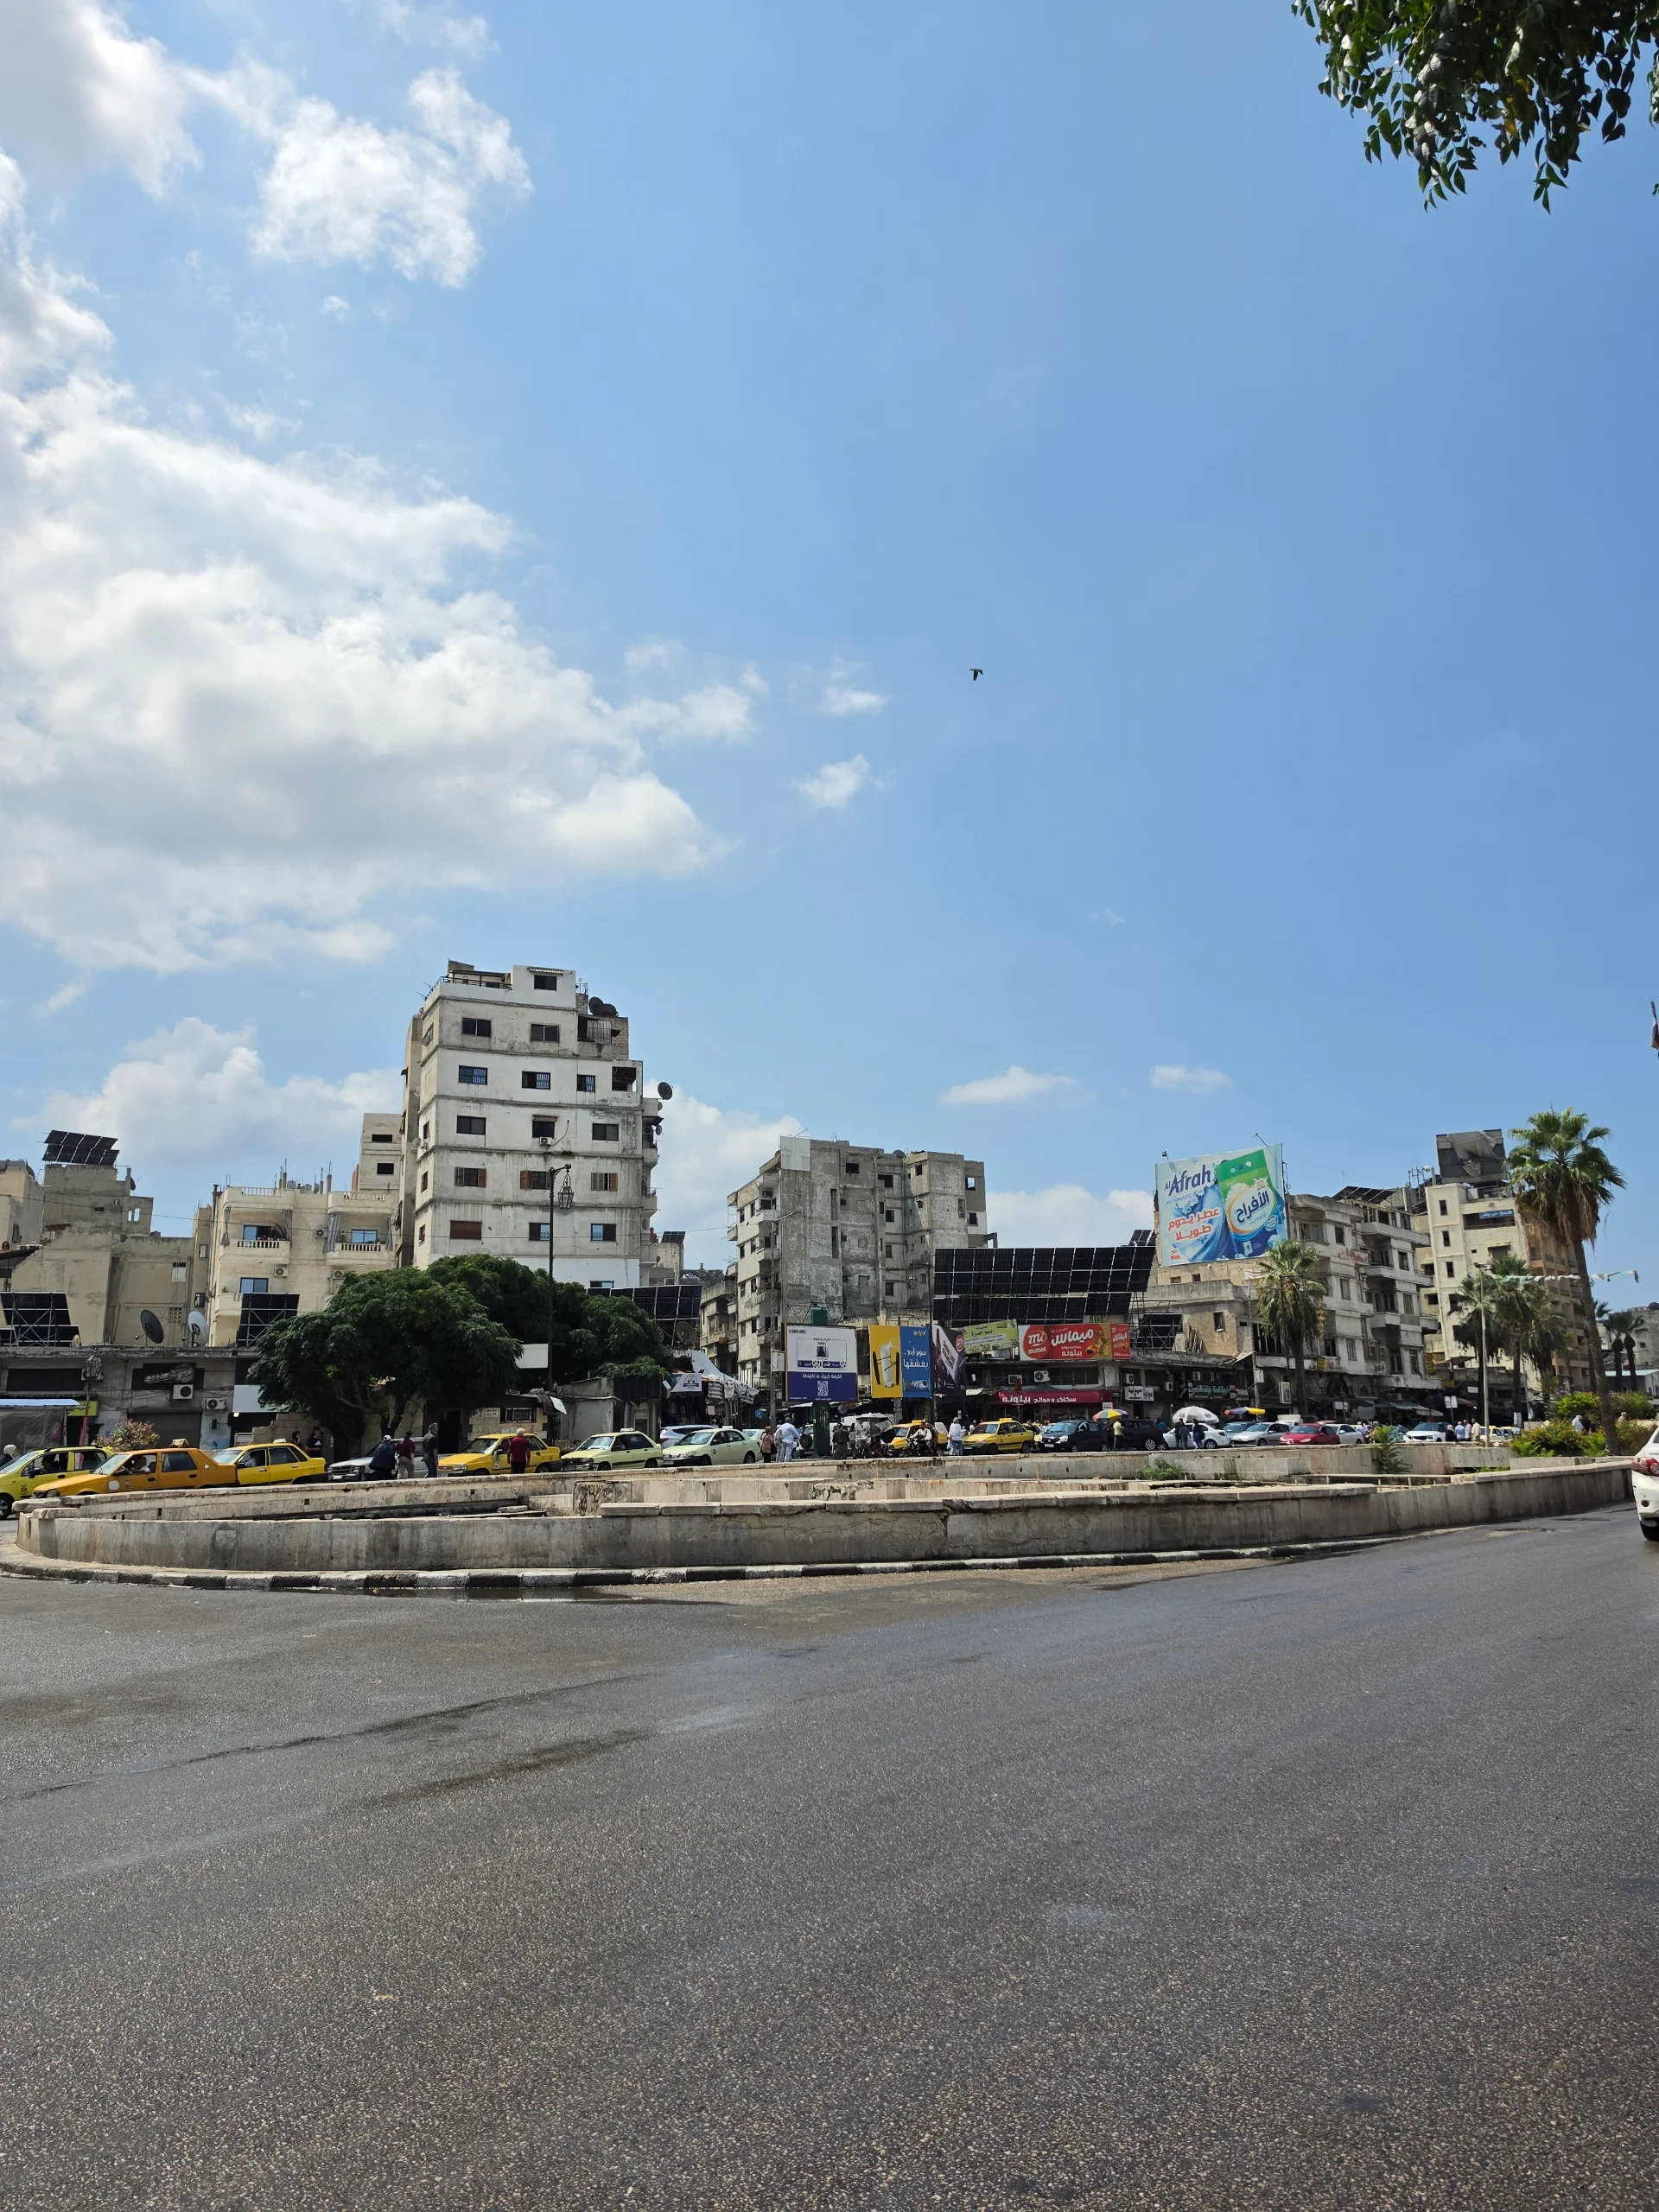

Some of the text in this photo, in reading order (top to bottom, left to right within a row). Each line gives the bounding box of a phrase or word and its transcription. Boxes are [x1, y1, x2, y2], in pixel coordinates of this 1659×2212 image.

[1164, 1164, 1211, 1196] Al Afrah
[1165, 1193, 1192, 1205] AUTOMATIC
[1235, 1191, 1270, 1224] الأفراح
[1168, 1208, 1219, 1231] عطر يدوم
[1051, 1329, 1094, 1346] ميماس
